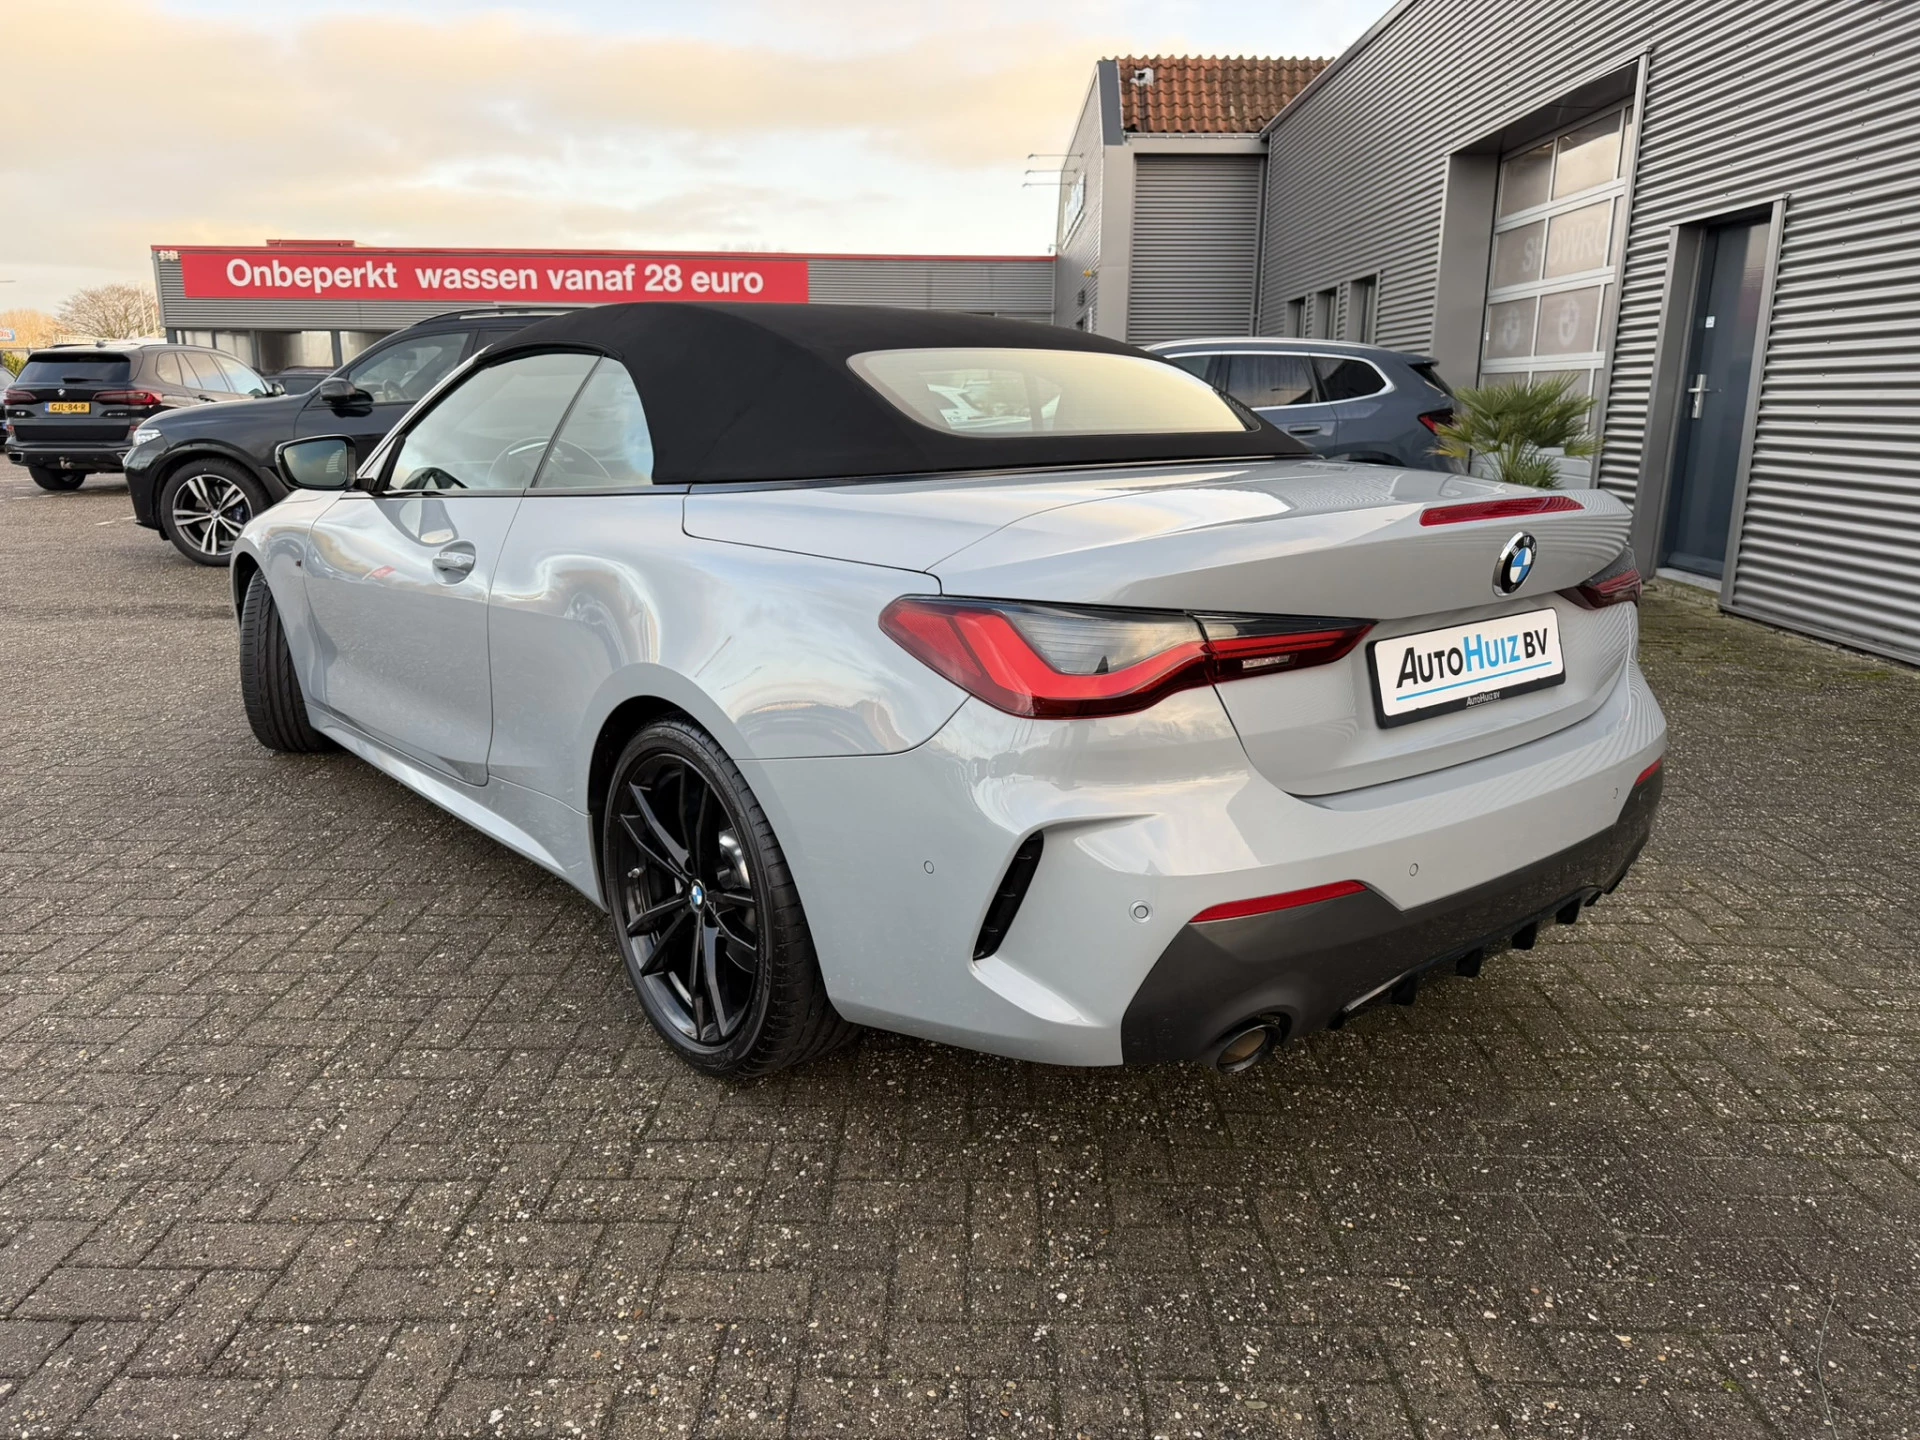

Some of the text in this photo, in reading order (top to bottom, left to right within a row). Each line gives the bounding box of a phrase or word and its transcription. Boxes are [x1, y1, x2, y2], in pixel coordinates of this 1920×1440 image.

[226, 258, 764, 294] Onbeperkt wassen vanaf 28 euro
[51, 403, 86, 412] GJL-84-R
[1523, 628, 1548, 659] BV
